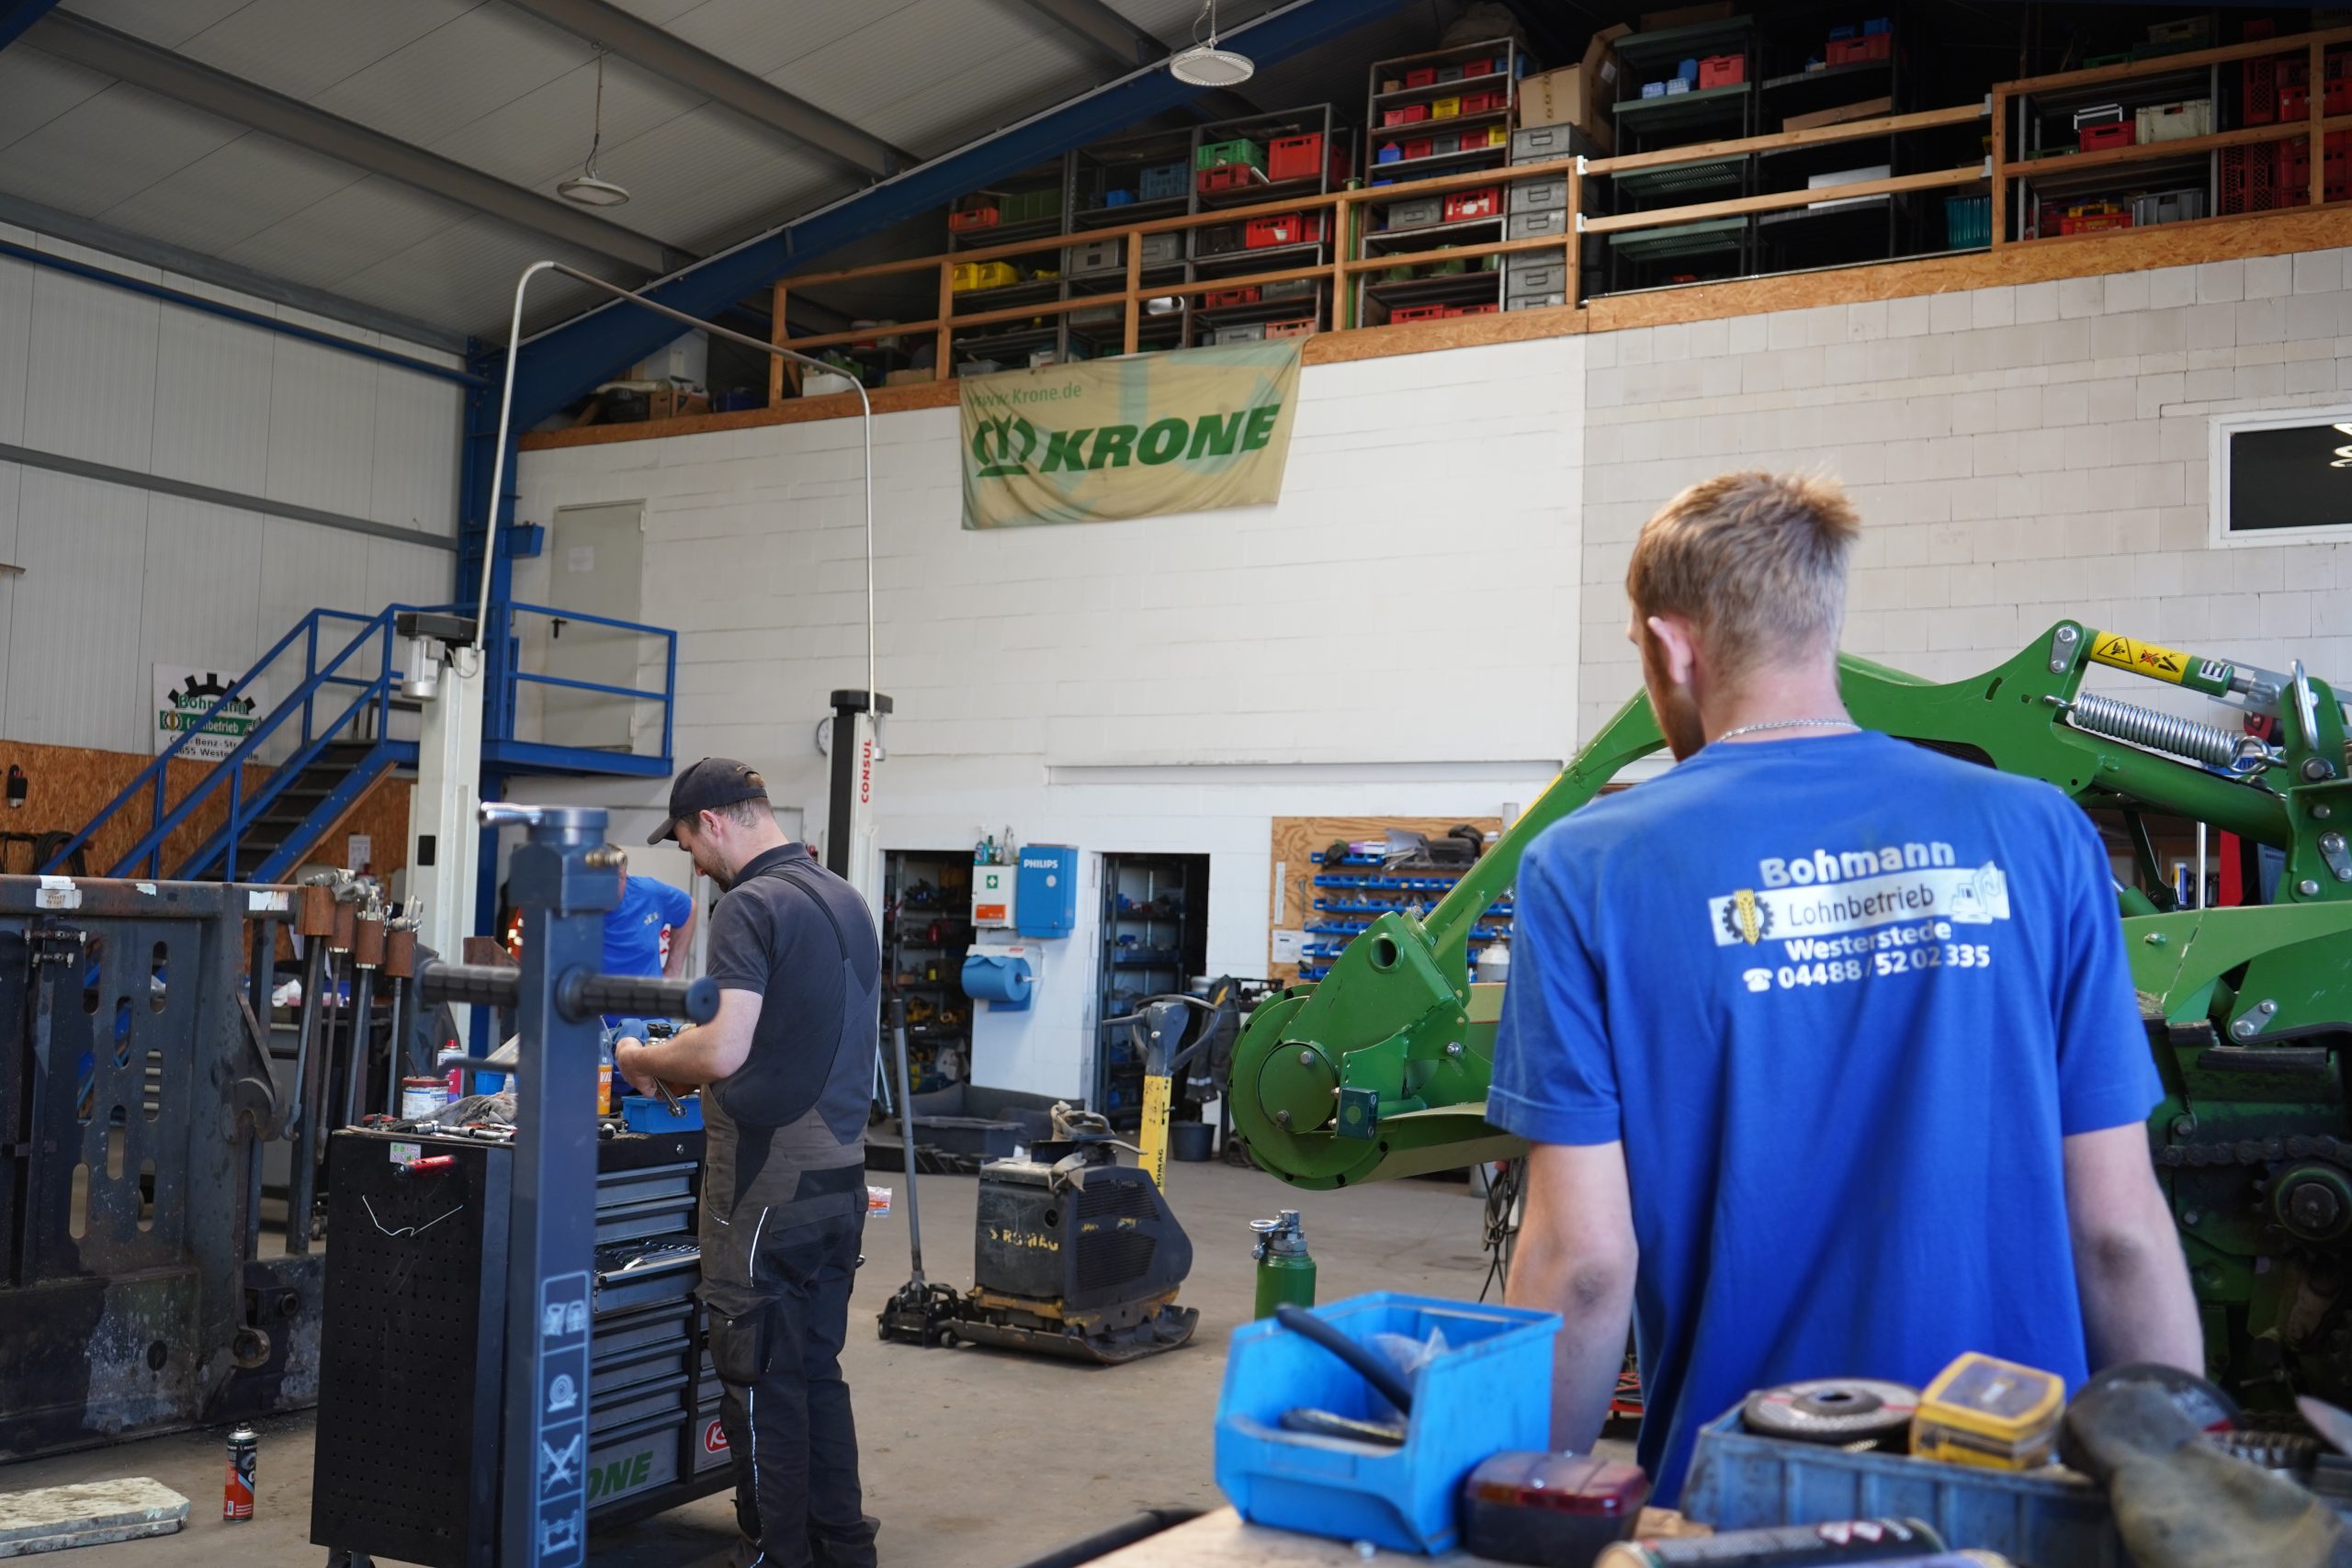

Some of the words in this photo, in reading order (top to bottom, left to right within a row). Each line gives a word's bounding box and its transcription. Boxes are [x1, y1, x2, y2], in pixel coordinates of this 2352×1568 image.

[1039, 403, 1281, 473] KRONE
[862, 739, 871, 803] CONSUL
[1023, 859, 1058, 869] PHILIPS
[1759, 841, 1956, 888] Bohmann
[1790, 884, 1935, 927] Lohnbetrieb
[1785, 921, 1951, 962] Westerstede
